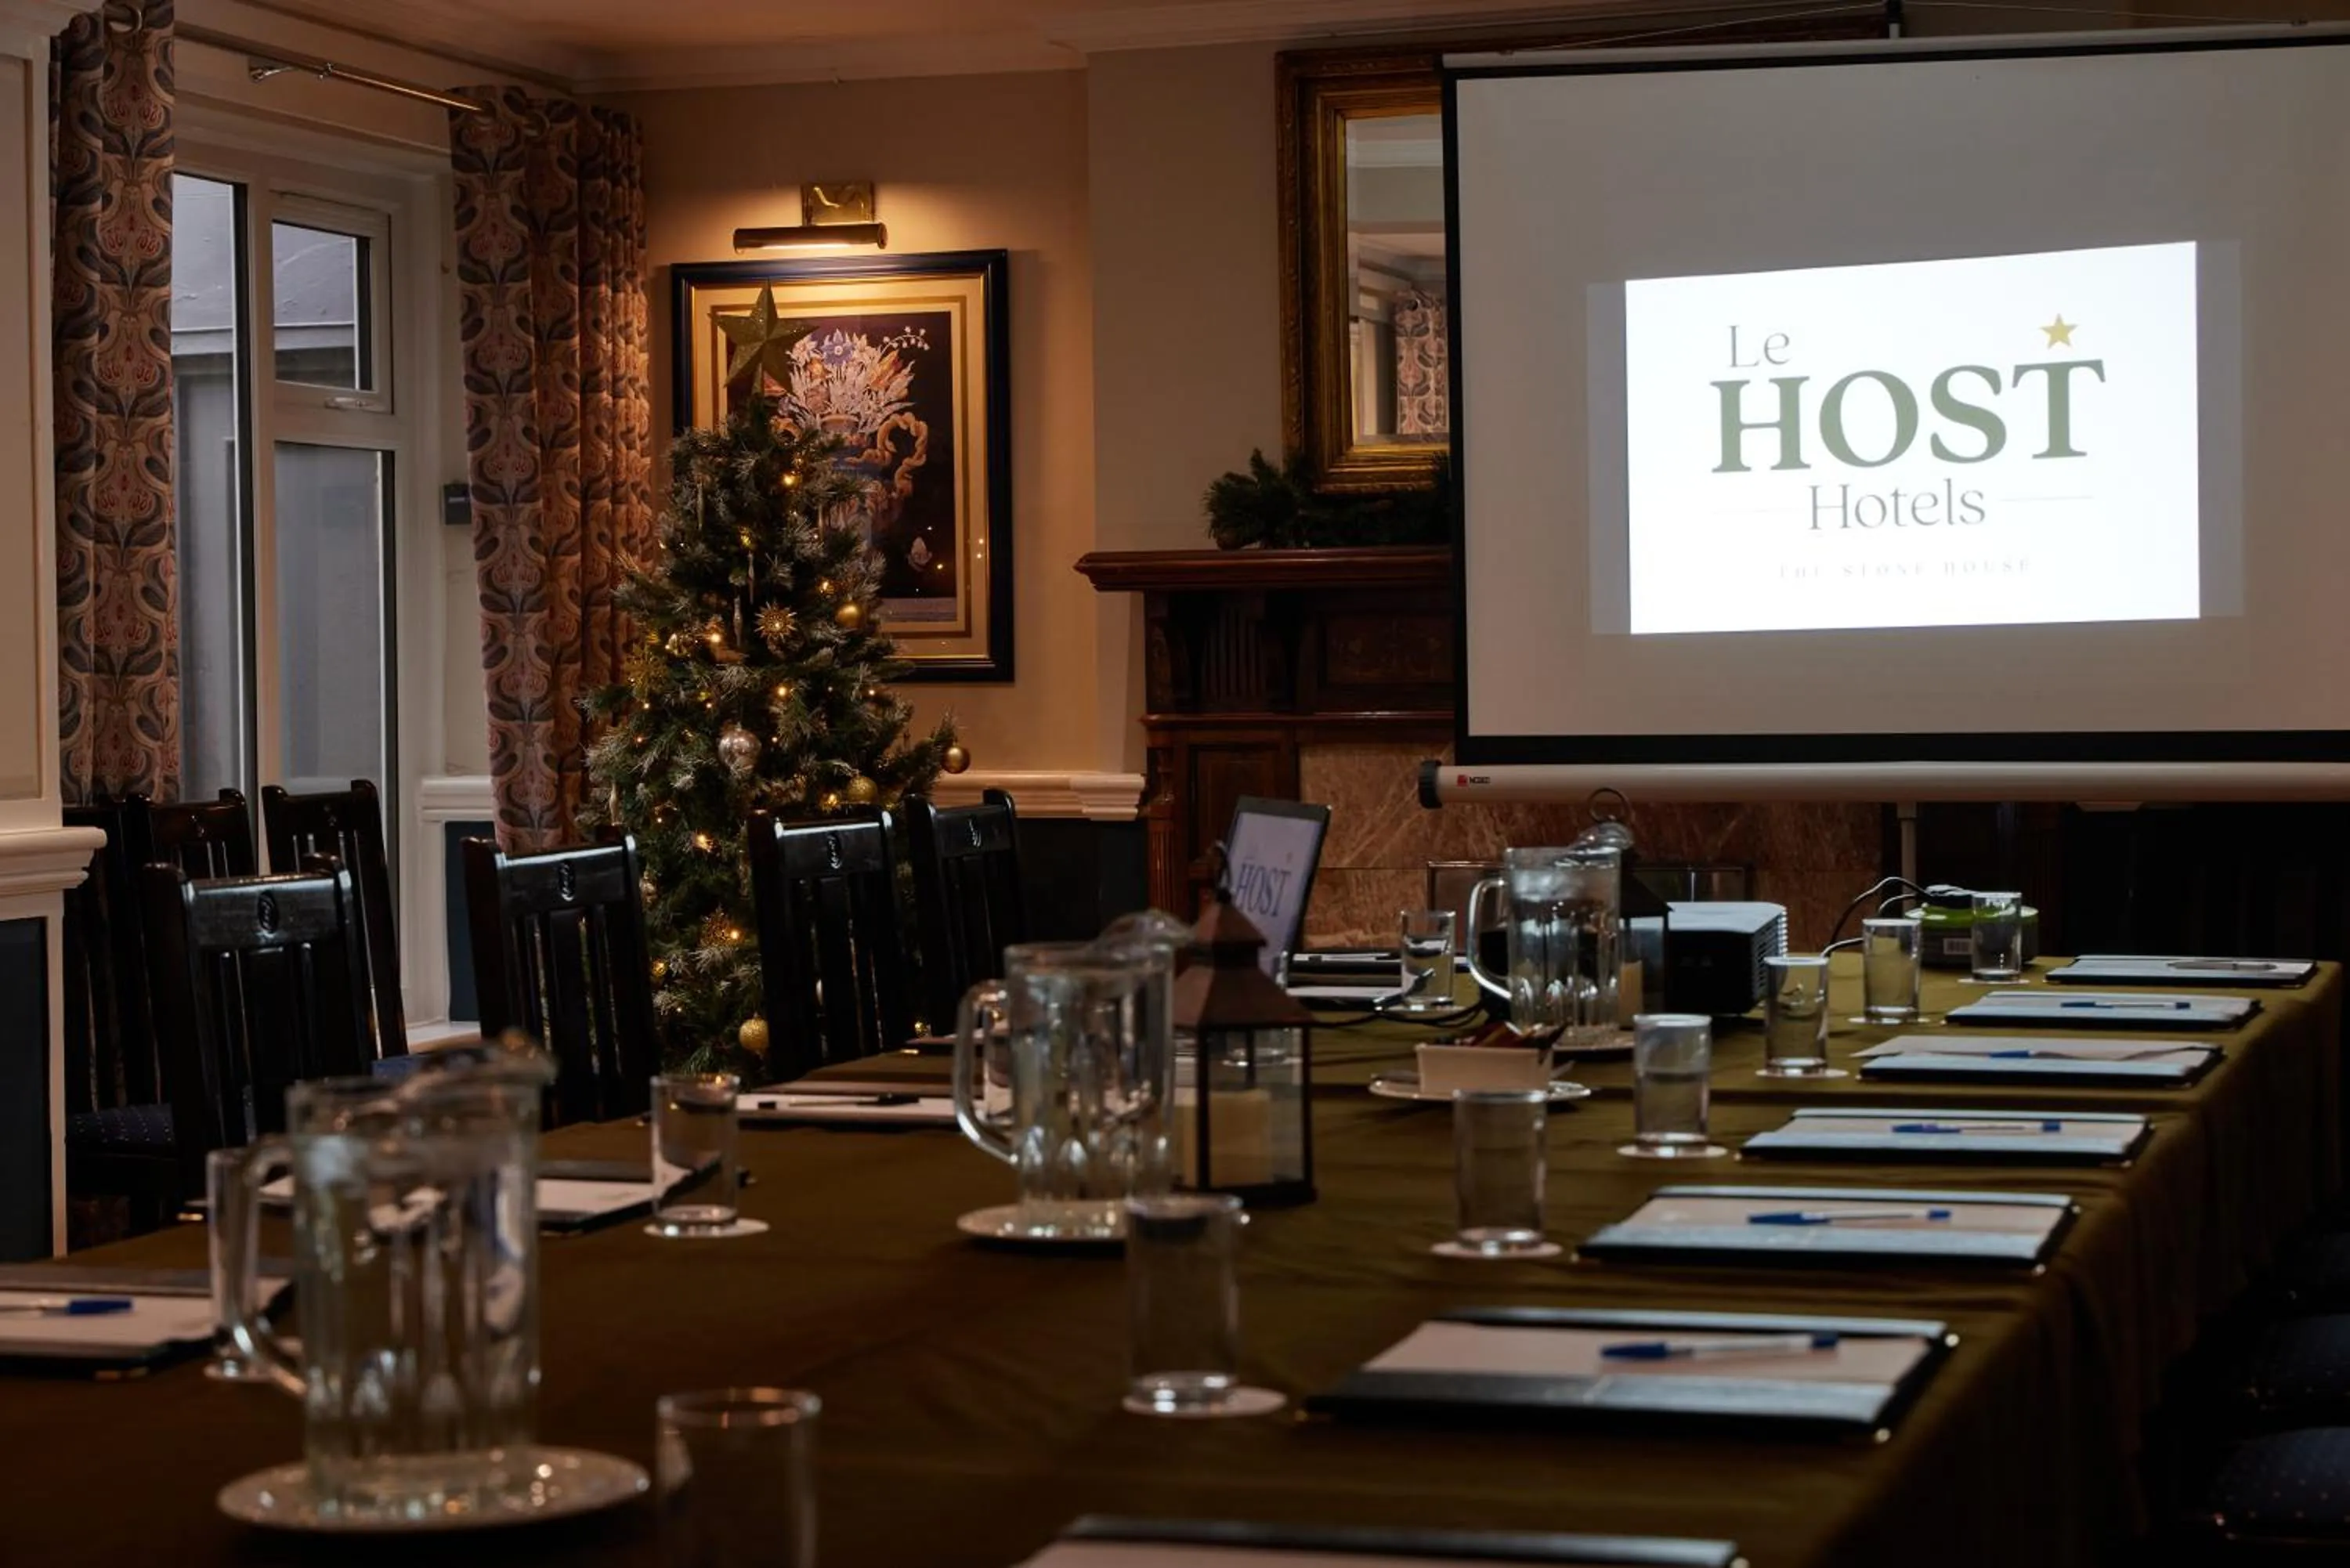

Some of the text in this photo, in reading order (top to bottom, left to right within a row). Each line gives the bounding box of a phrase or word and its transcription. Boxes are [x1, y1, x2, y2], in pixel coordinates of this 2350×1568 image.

[1728, 324, 1791, 368] Le
[1709, 359, 2106, 474] HOST
[1809, 477, 1987, 531] Hotels
[1235, 862, 1292, 918] HOST
